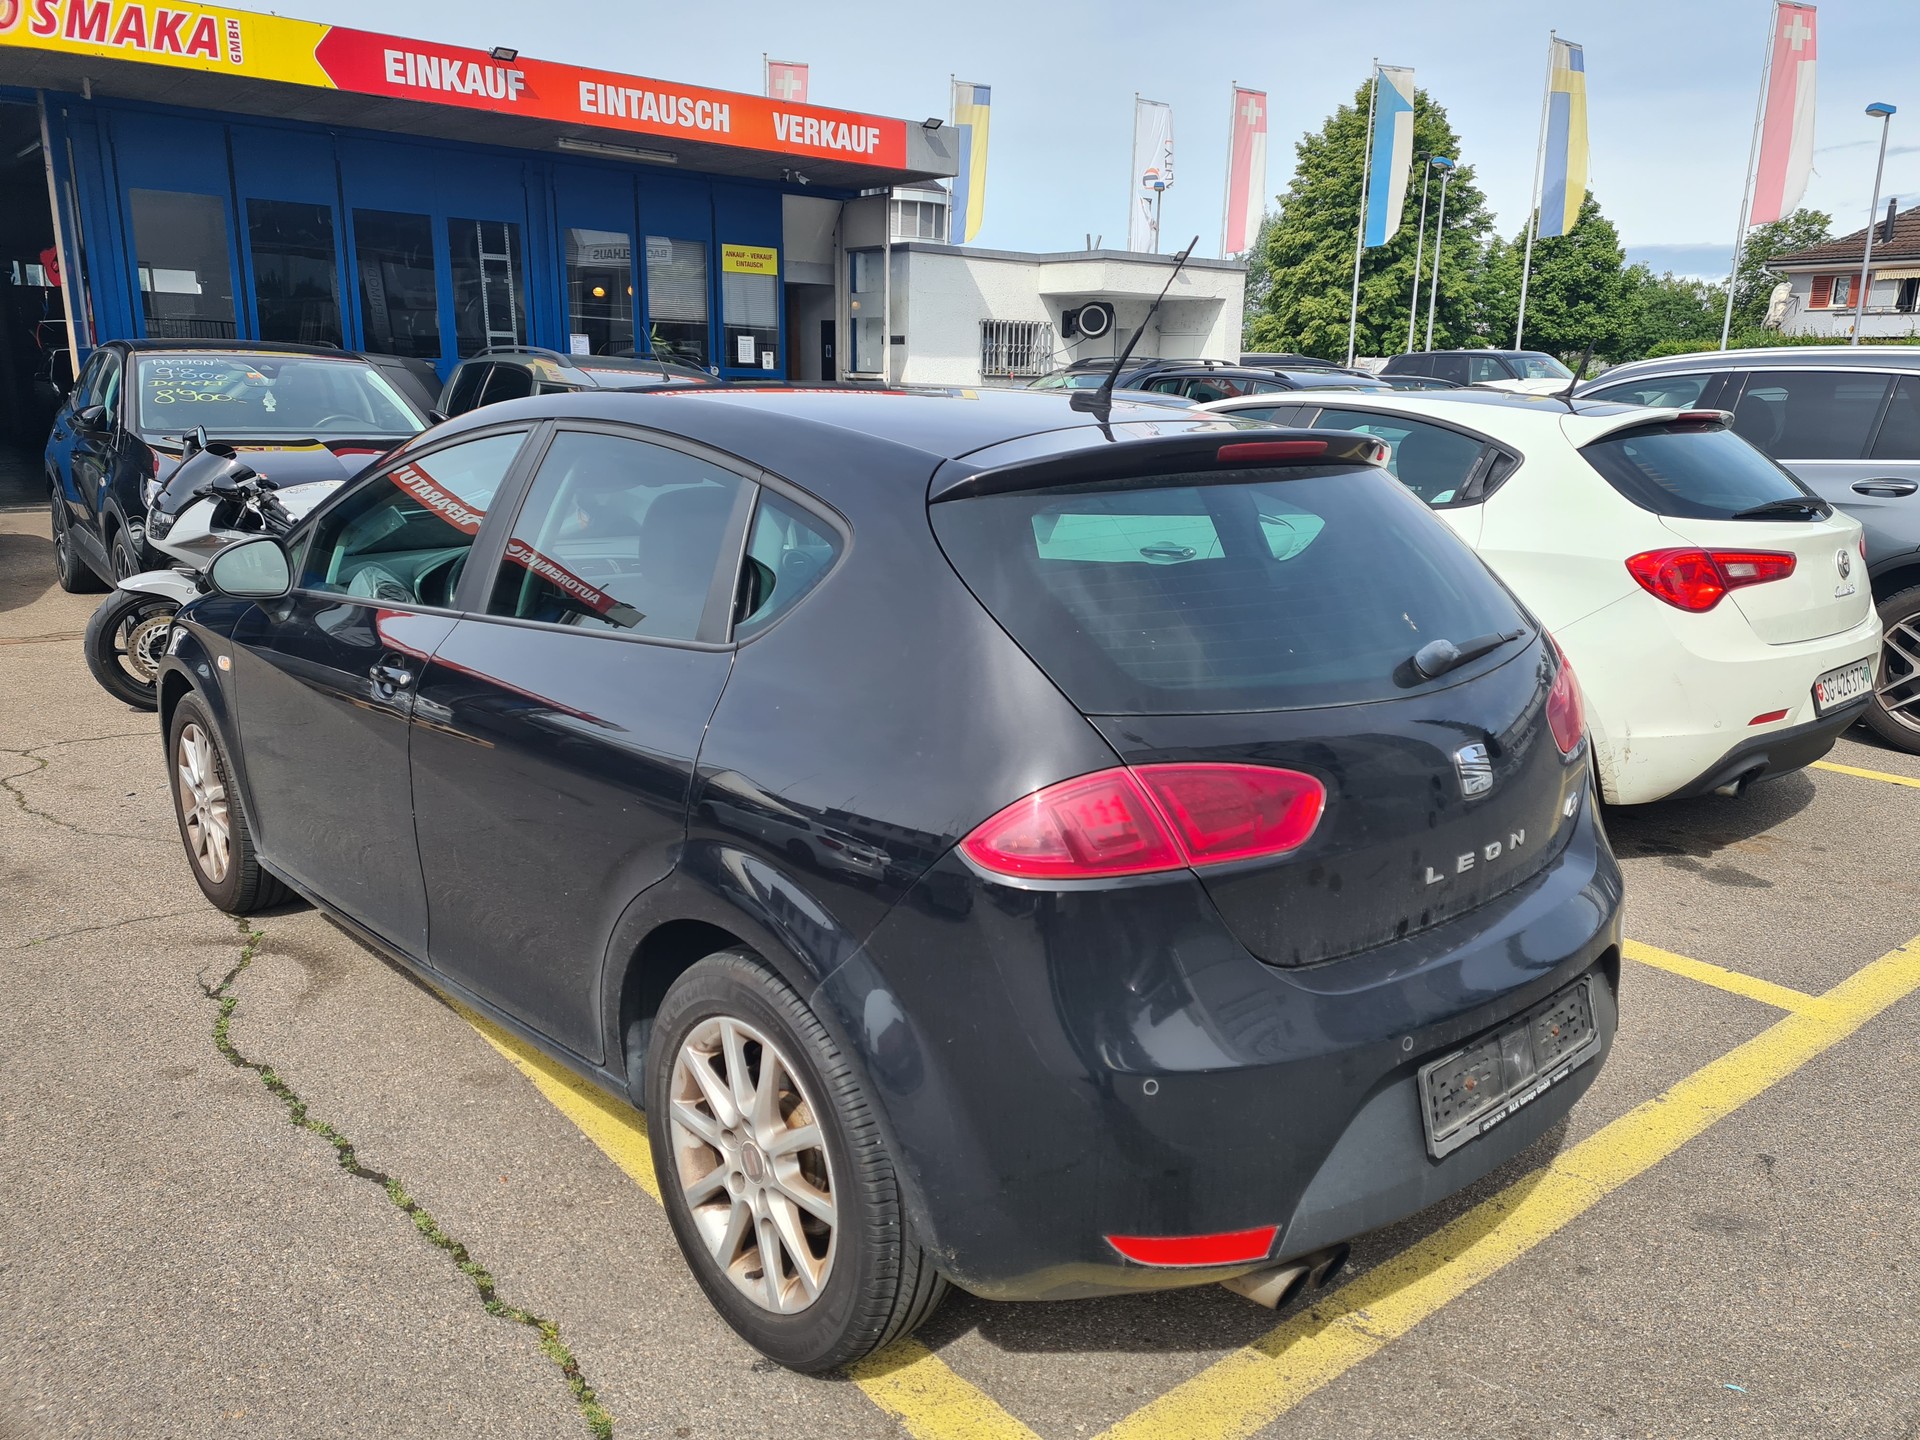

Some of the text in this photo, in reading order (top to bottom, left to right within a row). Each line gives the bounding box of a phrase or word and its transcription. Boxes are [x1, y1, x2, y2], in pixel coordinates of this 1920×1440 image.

[227, 19, 242, 63] GMBH
[384, 49, 880, 154] EINKAUF EINTAUSCH VERKAUF
[725, 250, 746, 258] ANKAUF
[750, 252, 773, 260] VERKAUF
[736, 260, 764, 269] EINTAUSCH
[1426, 829, 1525, 885] LEON
